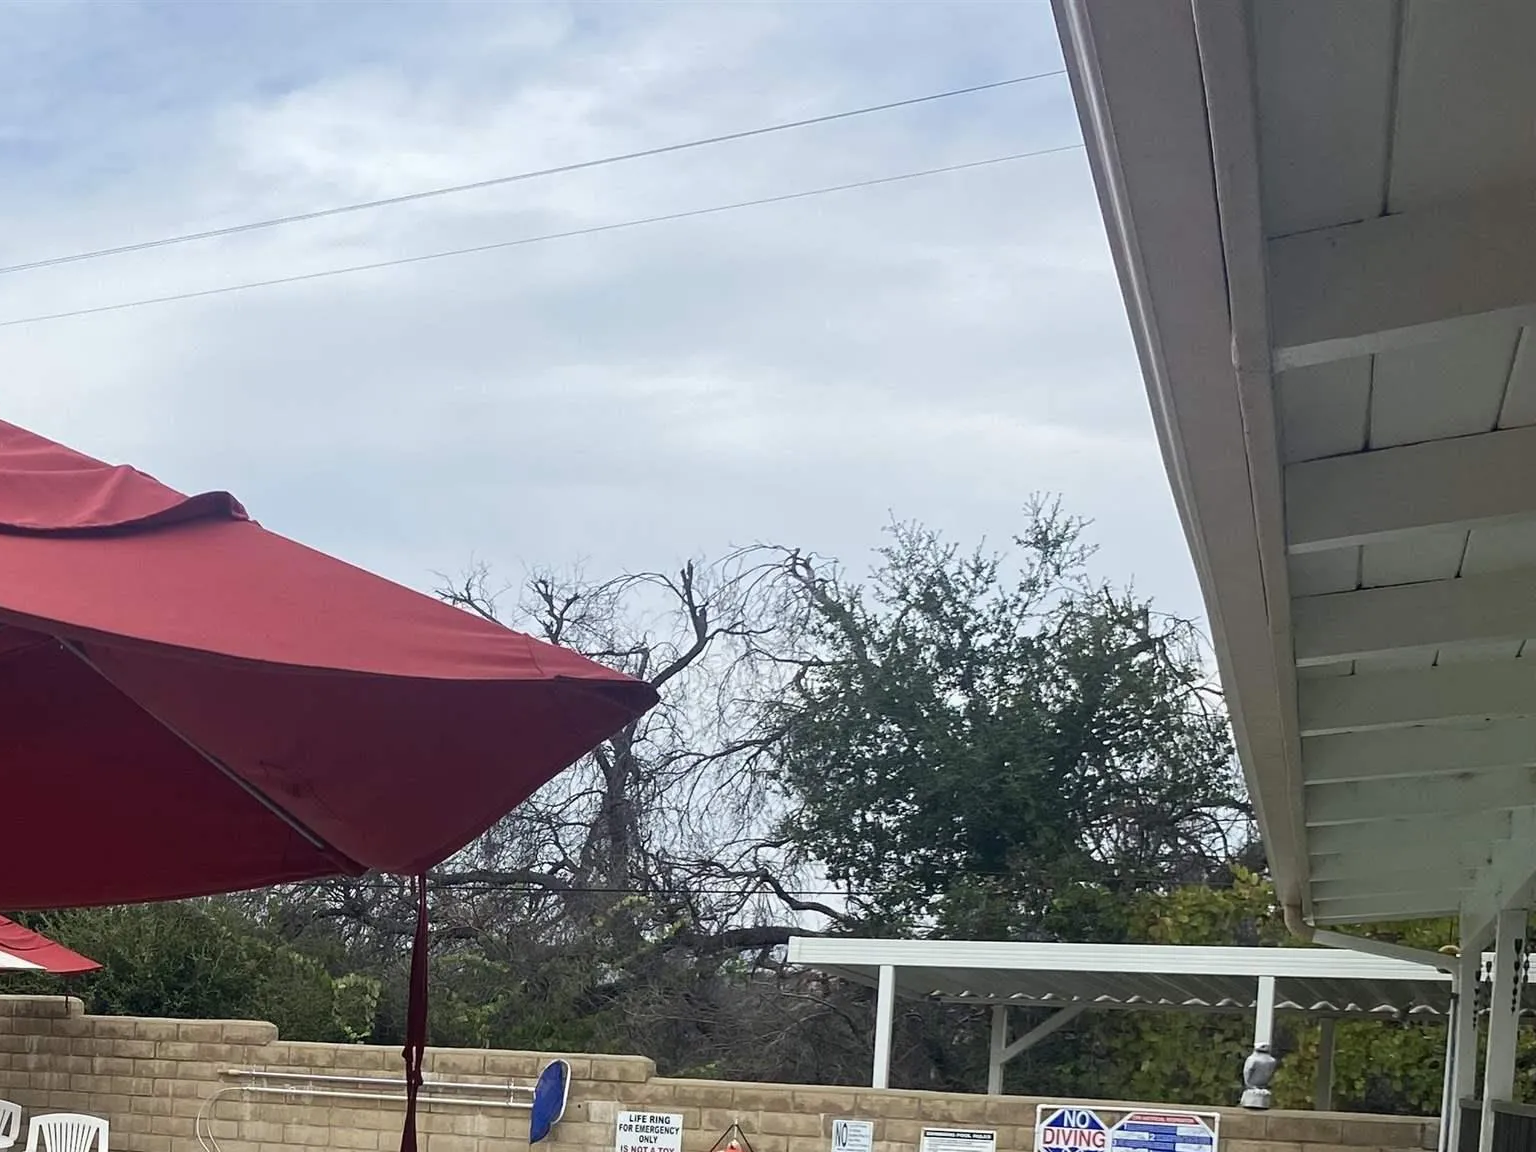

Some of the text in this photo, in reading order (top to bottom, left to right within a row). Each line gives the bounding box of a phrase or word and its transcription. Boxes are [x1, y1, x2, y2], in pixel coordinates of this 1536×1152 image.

[629, 1114, 671, 1125] LIFE RING
[1064, 1110, 1090, 1129] NO
[619, 1124, 680, 1135] FOR EMERGENCY
[836, 1122, 848, 1147] NO
[639, 1135, 658, 1144] ONLY
[1043, 1128, 1106, 1148] DIVING
[620, 1144, 629, 1152] IS
